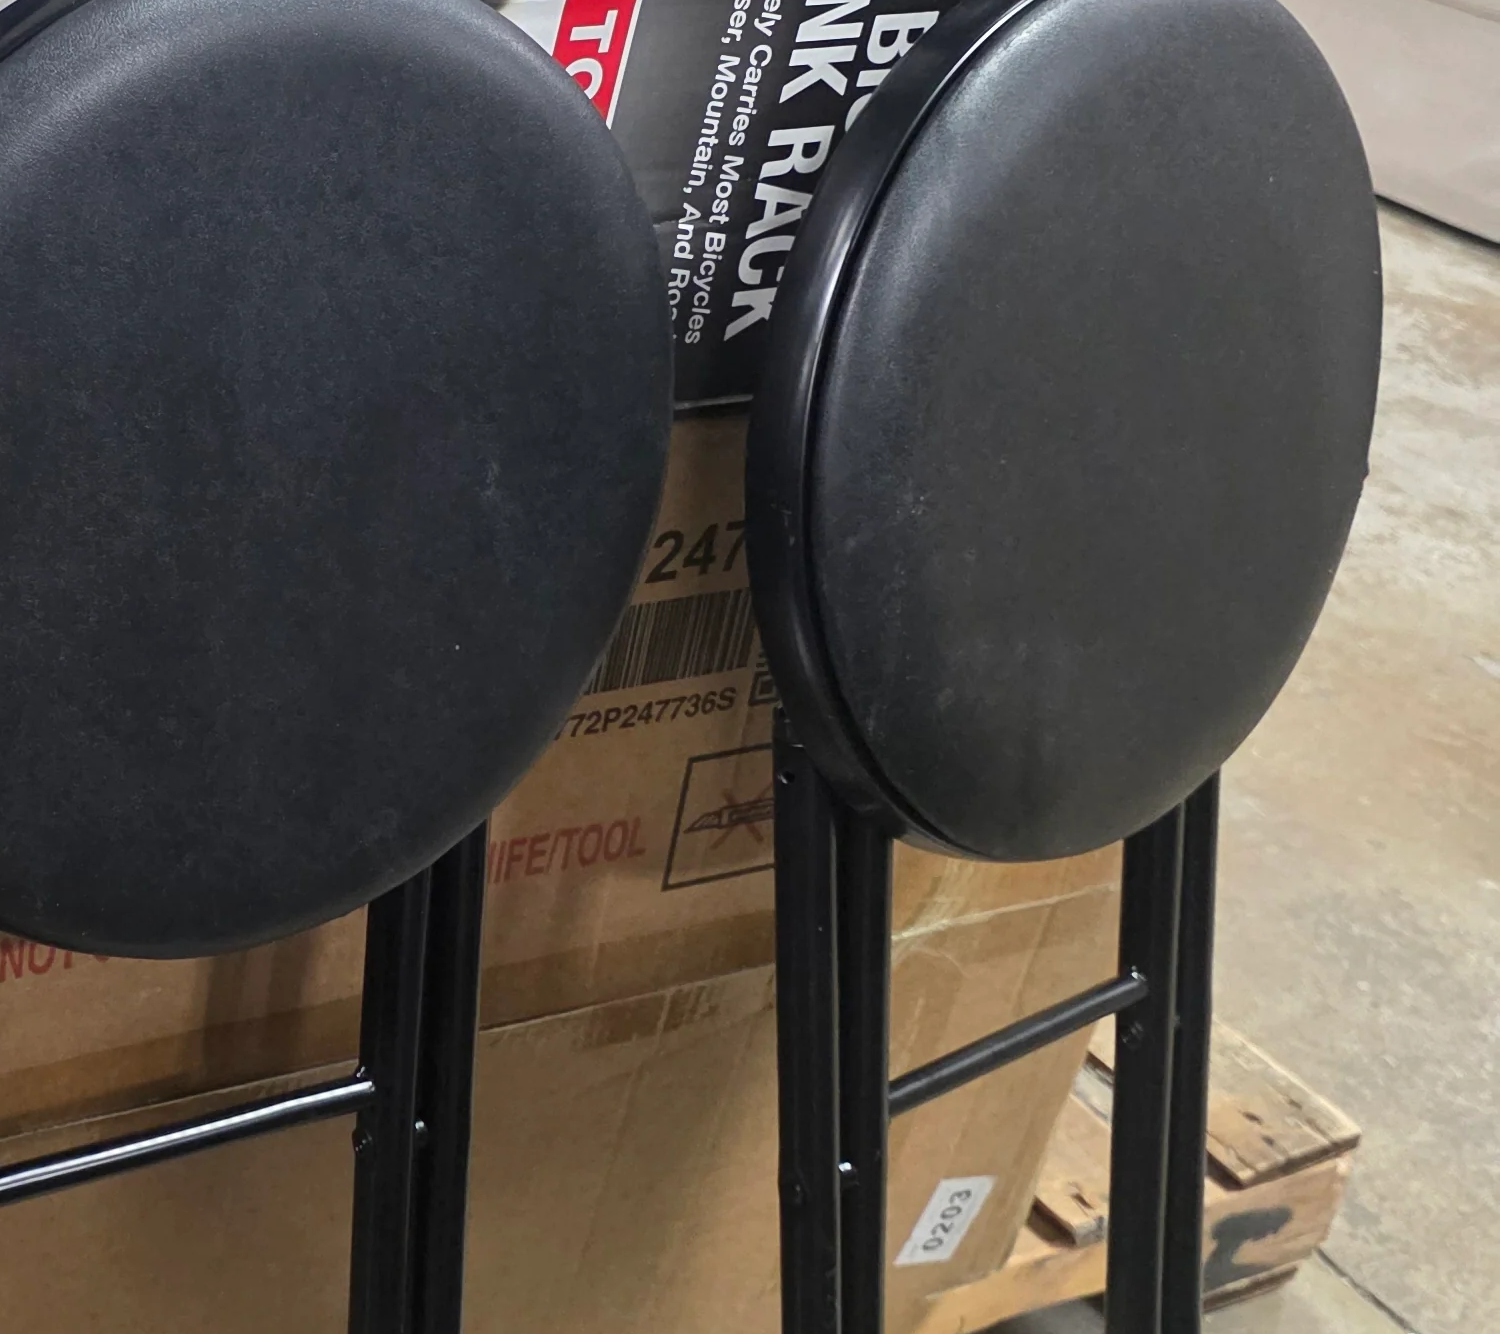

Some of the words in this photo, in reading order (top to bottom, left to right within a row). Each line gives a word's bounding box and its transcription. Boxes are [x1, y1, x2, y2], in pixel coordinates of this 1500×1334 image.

[682, 54, 741, 195] Mountain,
[728, 43, 773, 147] Carries
[673, 201, 702, 260] And
[708, 154, 745, 225] Most
[723, 124, 836, 342] RACK
[667, 267, 691, 340] Ro
[684, 231, 727, 344] Bicycles
[554, 687, 738, 741] 72P247736S
